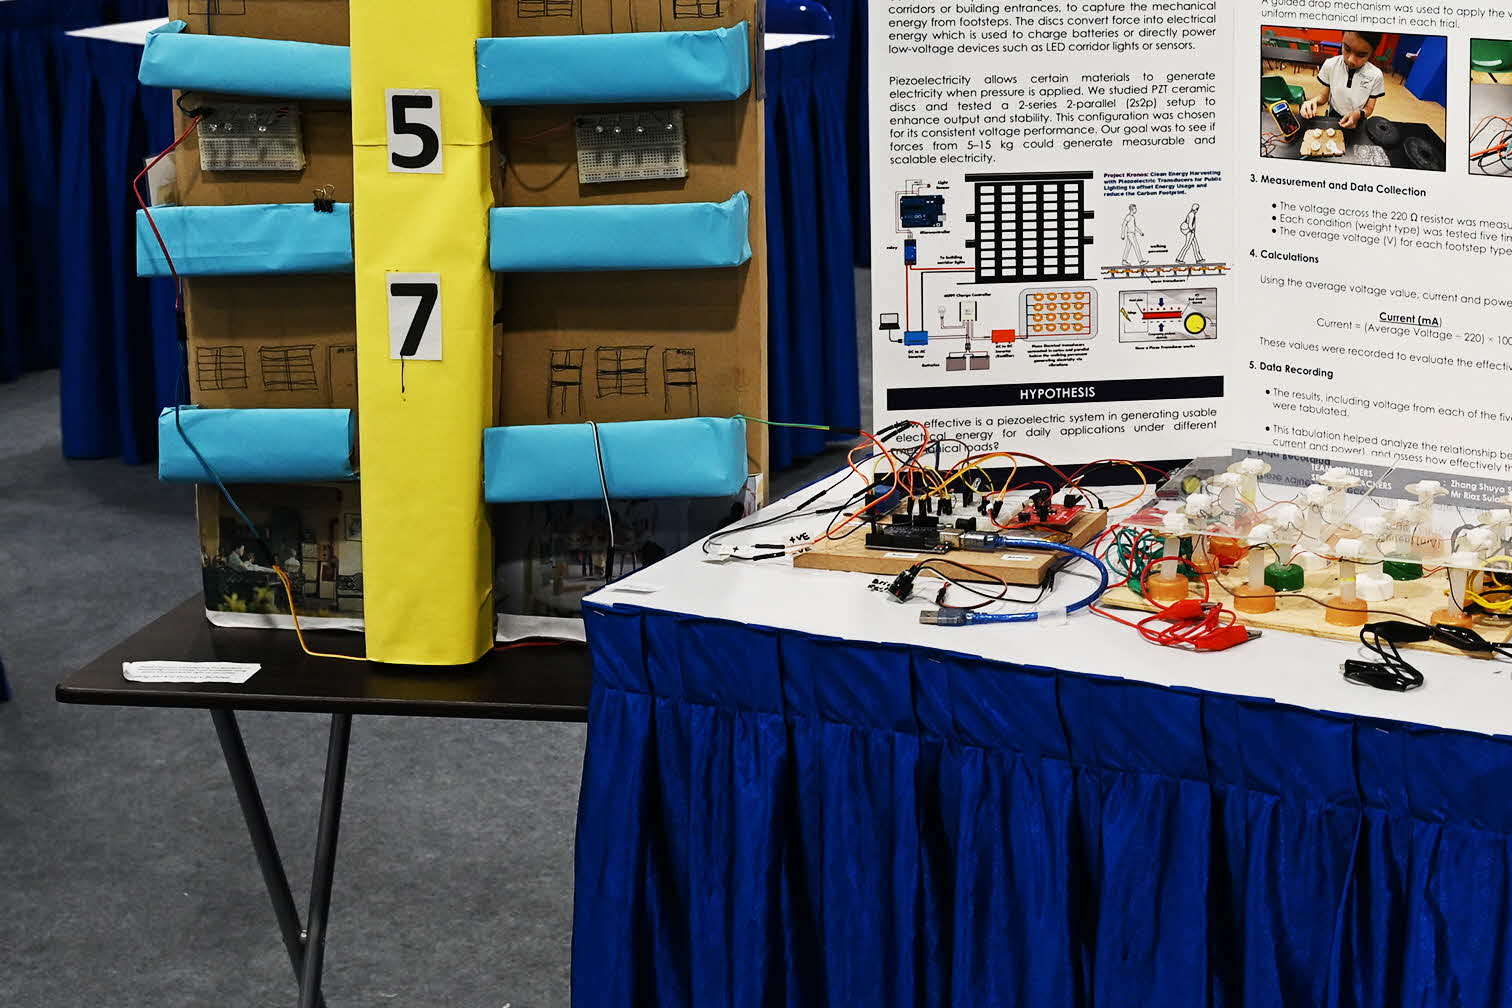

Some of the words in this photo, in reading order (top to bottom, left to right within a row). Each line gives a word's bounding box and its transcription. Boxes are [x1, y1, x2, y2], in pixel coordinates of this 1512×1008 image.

[391, 94, 440, 169] 5
[1250, 173, 1258, 183] 3.
[1260, 174, 1326, 188] Measurement
[1328, 181, 1348, 190] and
[1350, 182, 1374, 192] Data
[1376, 184, 1426, 197] Collection
[1249, 248, 1258, 258] 4.
[1260, 249, 1319, 264] Calculations
[390, 282, 438, 356] 7
[1379, 312, 1415, 325] Current
[1418, 314, 1442, 328] (mA)
[1248, 360, 1256, 369] 5.
[1259, 361, 1282, 372] Data
[1284, 364, 1334, 380] Recording
[1020, 386, 1096, 400] HYPOTHESIS
[1451, 480, 1477, 491] Zhang
[1479, 482, 1505, 494] Shuya
